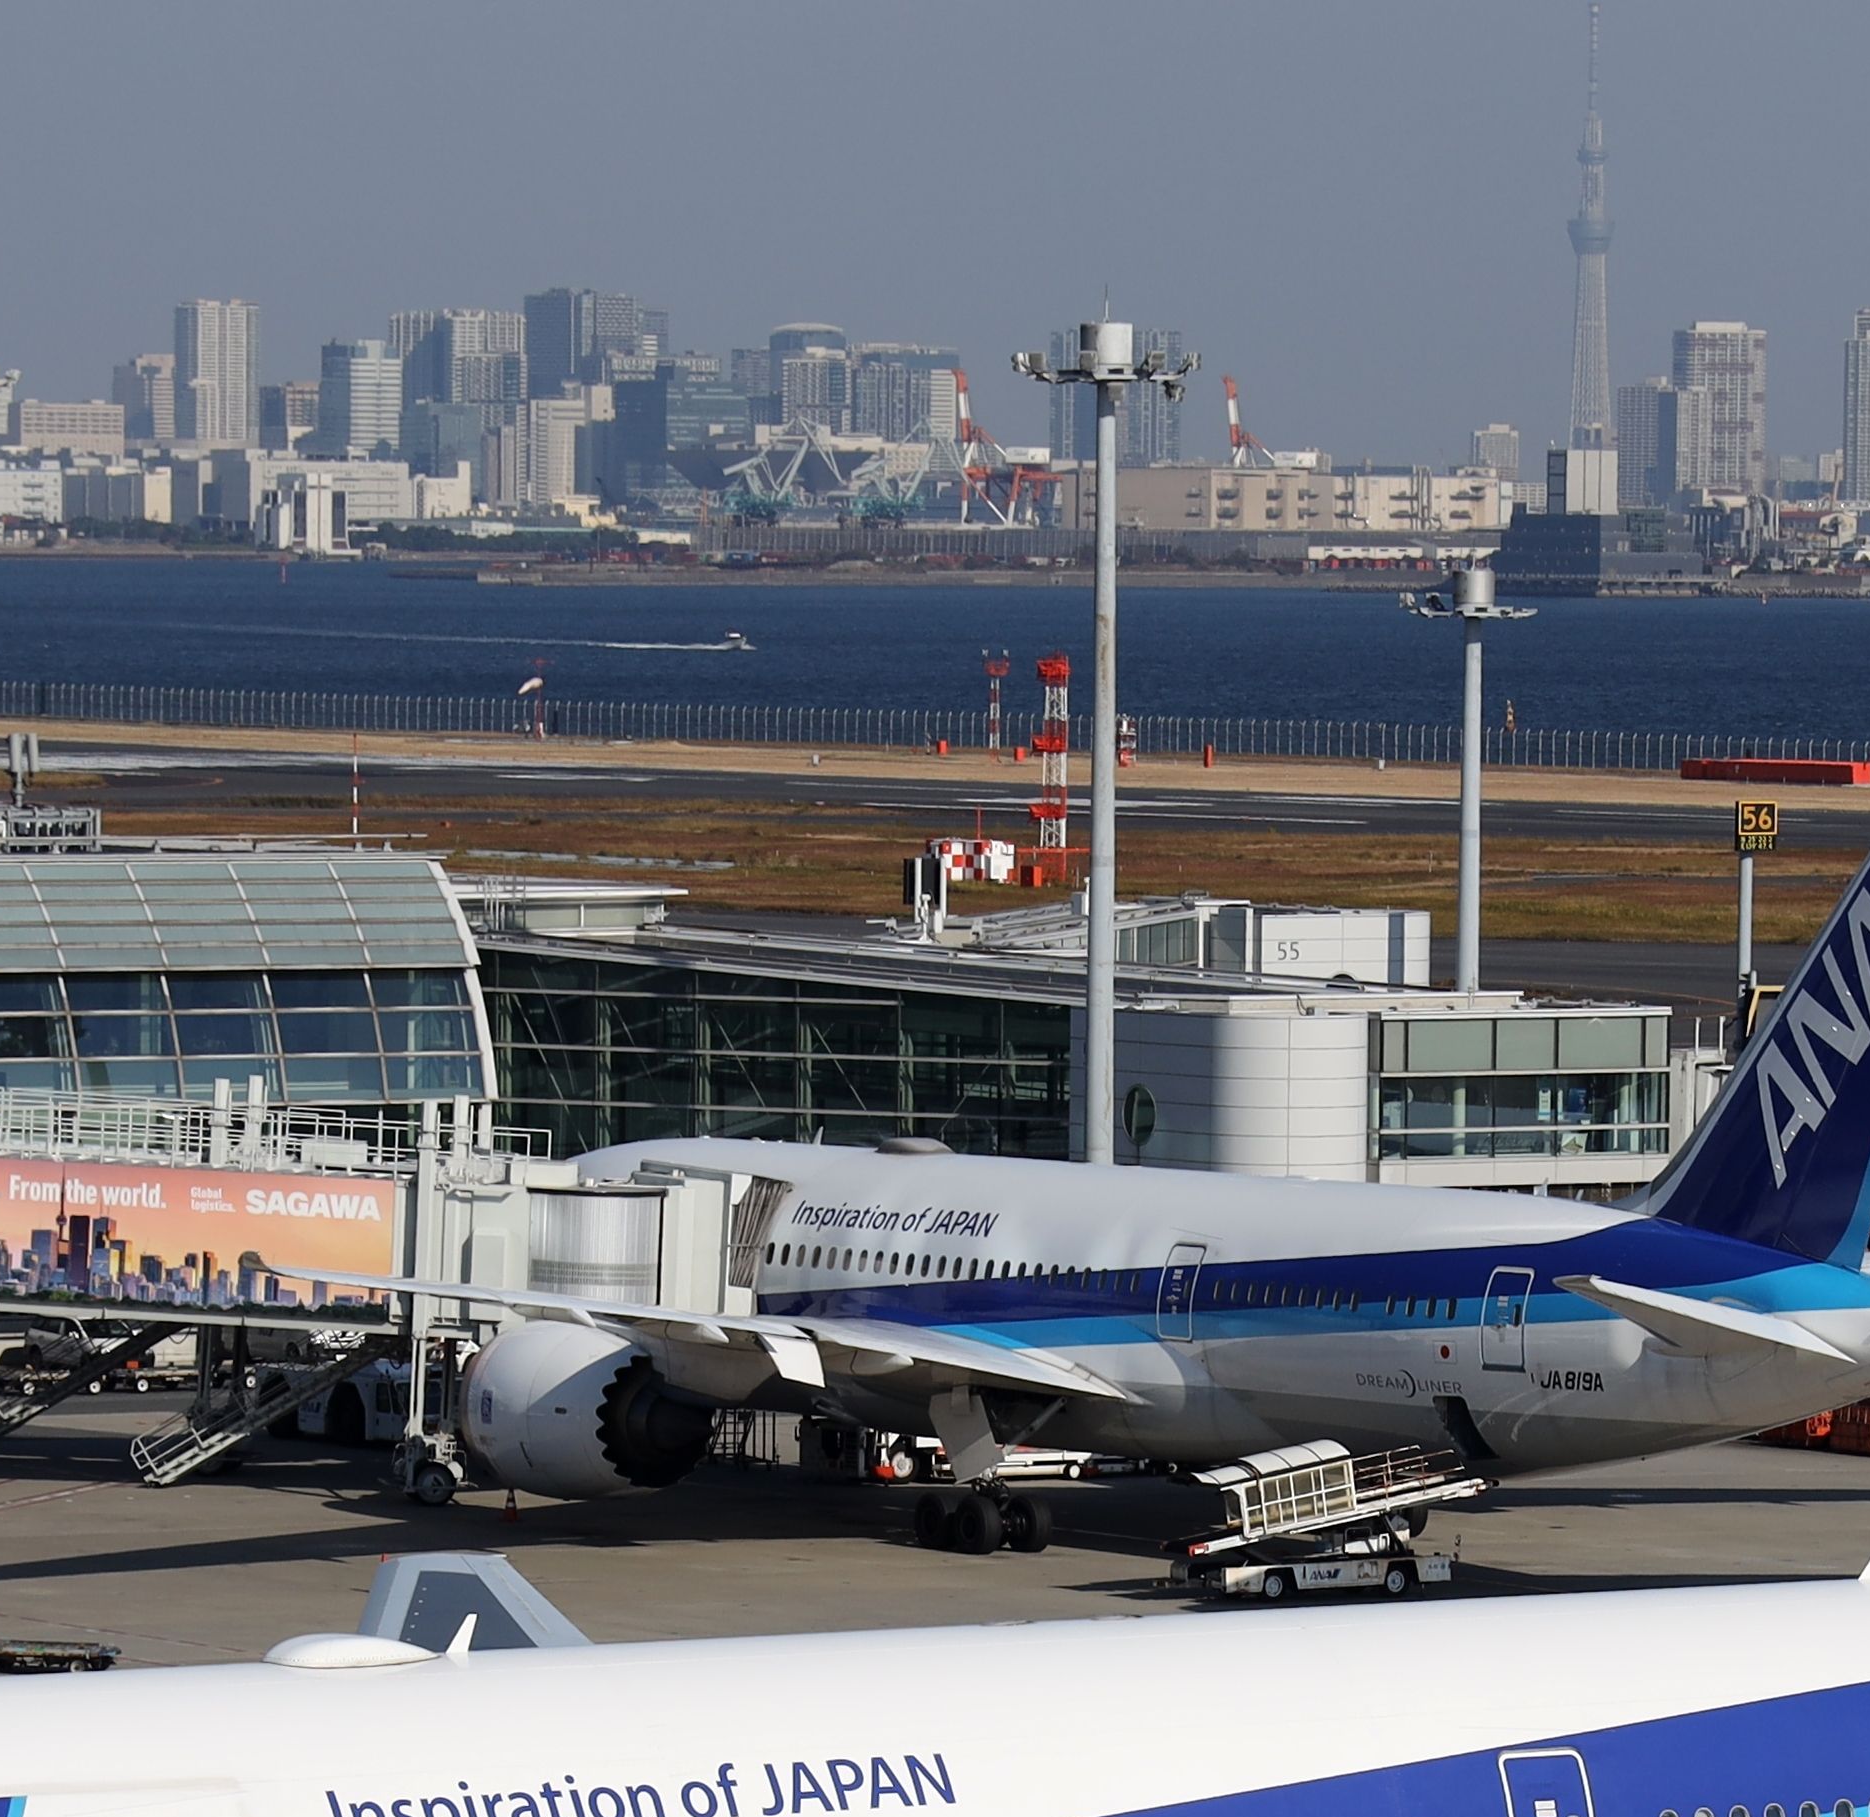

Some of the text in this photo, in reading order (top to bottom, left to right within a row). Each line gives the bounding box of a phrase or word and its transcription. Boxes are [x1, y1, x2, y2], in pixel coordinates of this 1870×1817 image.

[1743, 806, 1772, 830] 56
[1278, 942, 1300, 961] 55
[9, 1174, 61, 1201] From
[65, 1179, 97, 1204] the
[101, 1182, 167, 1209] world.
[190, 1186, 223, 1199] Global
[245, 1188, 381, 1221] SAGAWA
[791, 1199, 1000, 1238] Inspiration of JAPAN
[1540, 1370, 1604, 1393] JA819A
[761, 1752, 957, 1817] JAPAN
